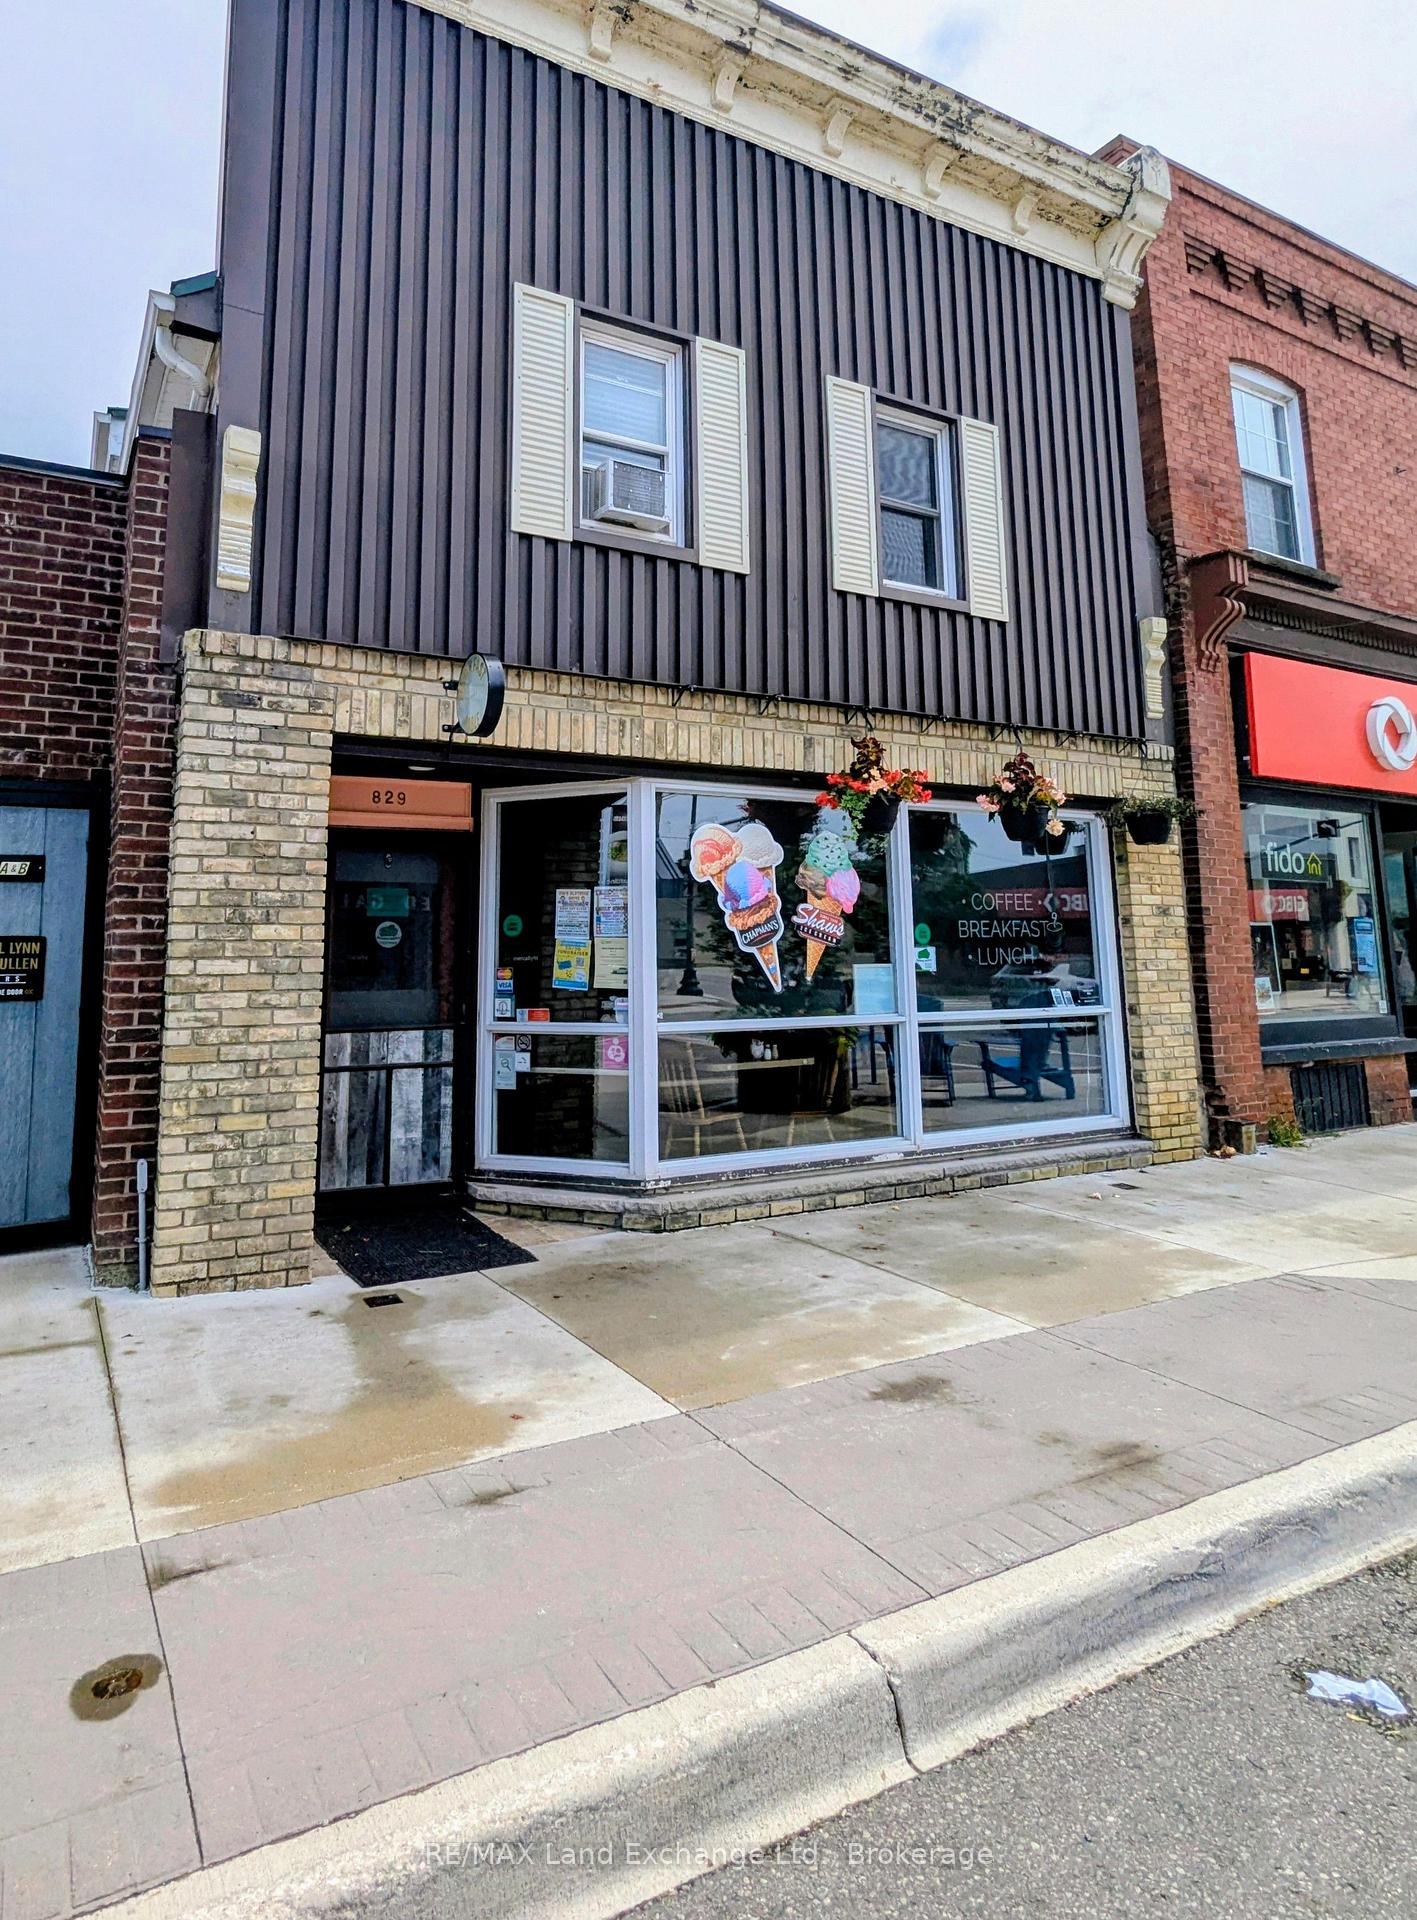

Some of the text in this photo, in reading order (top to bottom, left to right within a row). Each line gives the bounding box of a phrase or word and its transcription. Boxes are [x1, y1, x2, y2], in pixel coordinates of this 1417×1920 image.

[372, 791, 406, 805] 829
[1265, 842, 1305, 874] fido
[971, 893, 1034, 911] COFFEE
[742, 920, 779, 944] CHAPMAN'S
[958, 920, 1049, 938] BREAKFAST
[9, 942, 41, 954] LYNN
[977, 947, 1035, 966] LUNCH
[0, 957, 39, 970] ULLEN
